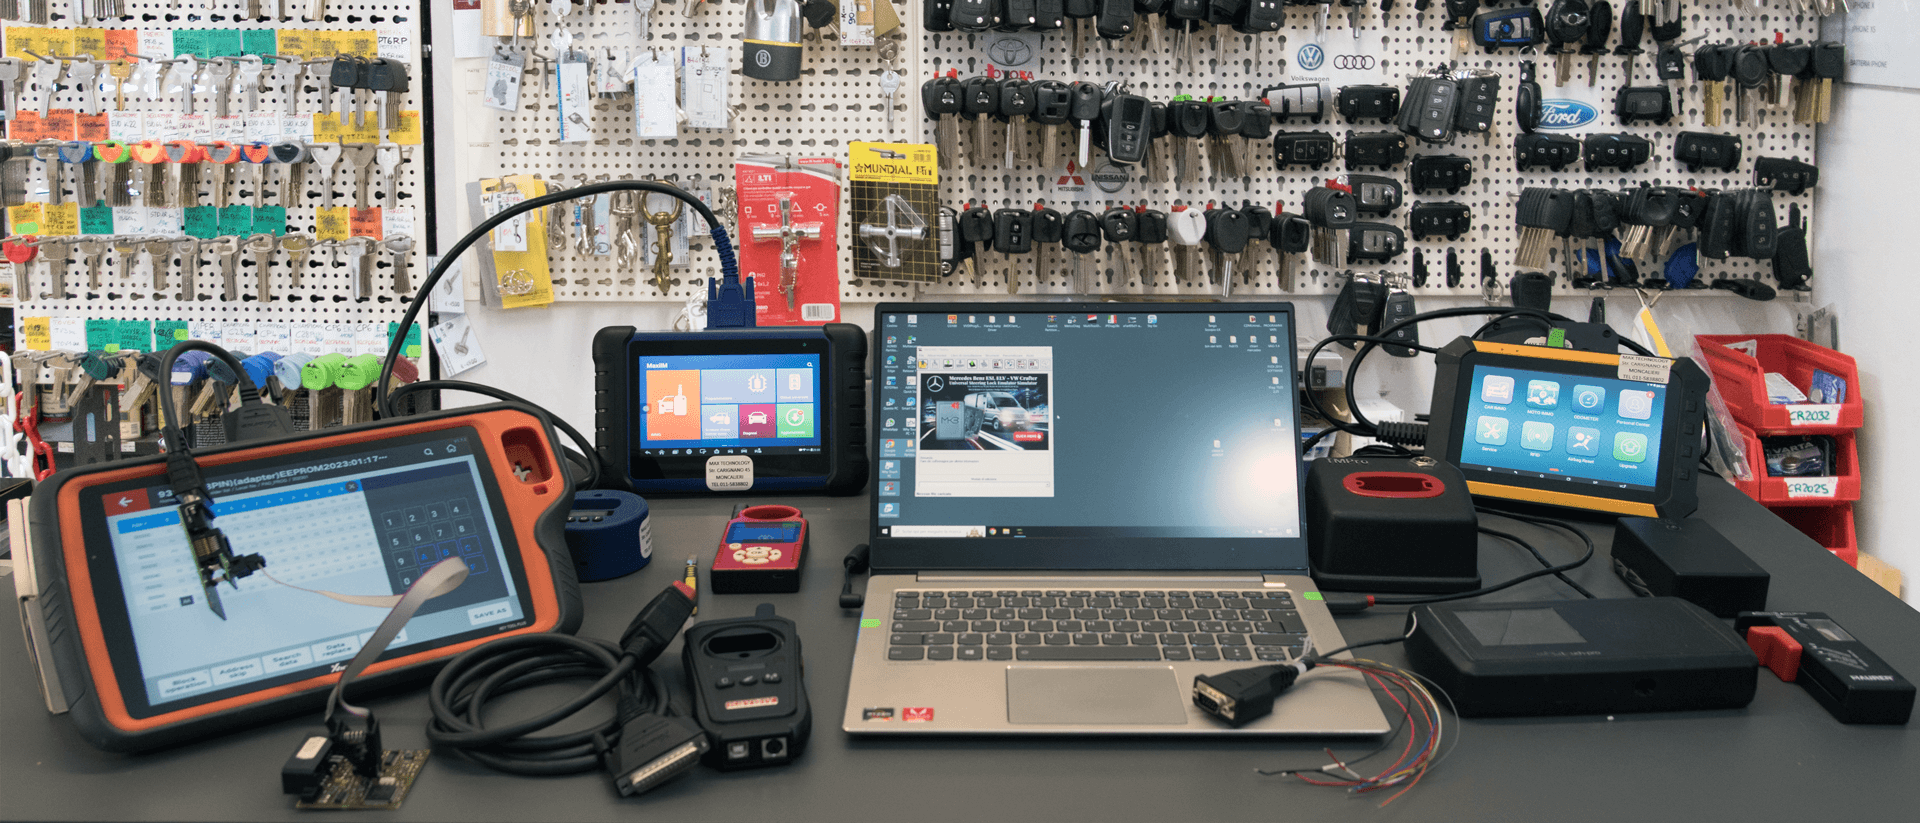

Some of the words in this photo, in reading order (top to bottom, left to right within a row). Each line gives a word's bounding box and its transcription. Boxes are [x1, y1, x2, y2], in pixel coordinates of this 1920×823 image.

[1290, 75, 1330, 83] Volkswagen
[1541, 103, 1582, 124] Ford
[1094, 173, 1128, 181] NISSAN
[1790, 410, 1831, 421] CR2032
[1772, 442, 1814, 454] VARTA
[1788, 482, 1829, 494] CR2025
[393, 538, 399, 546] 5
[474, 611, 493, 620] SAVE
